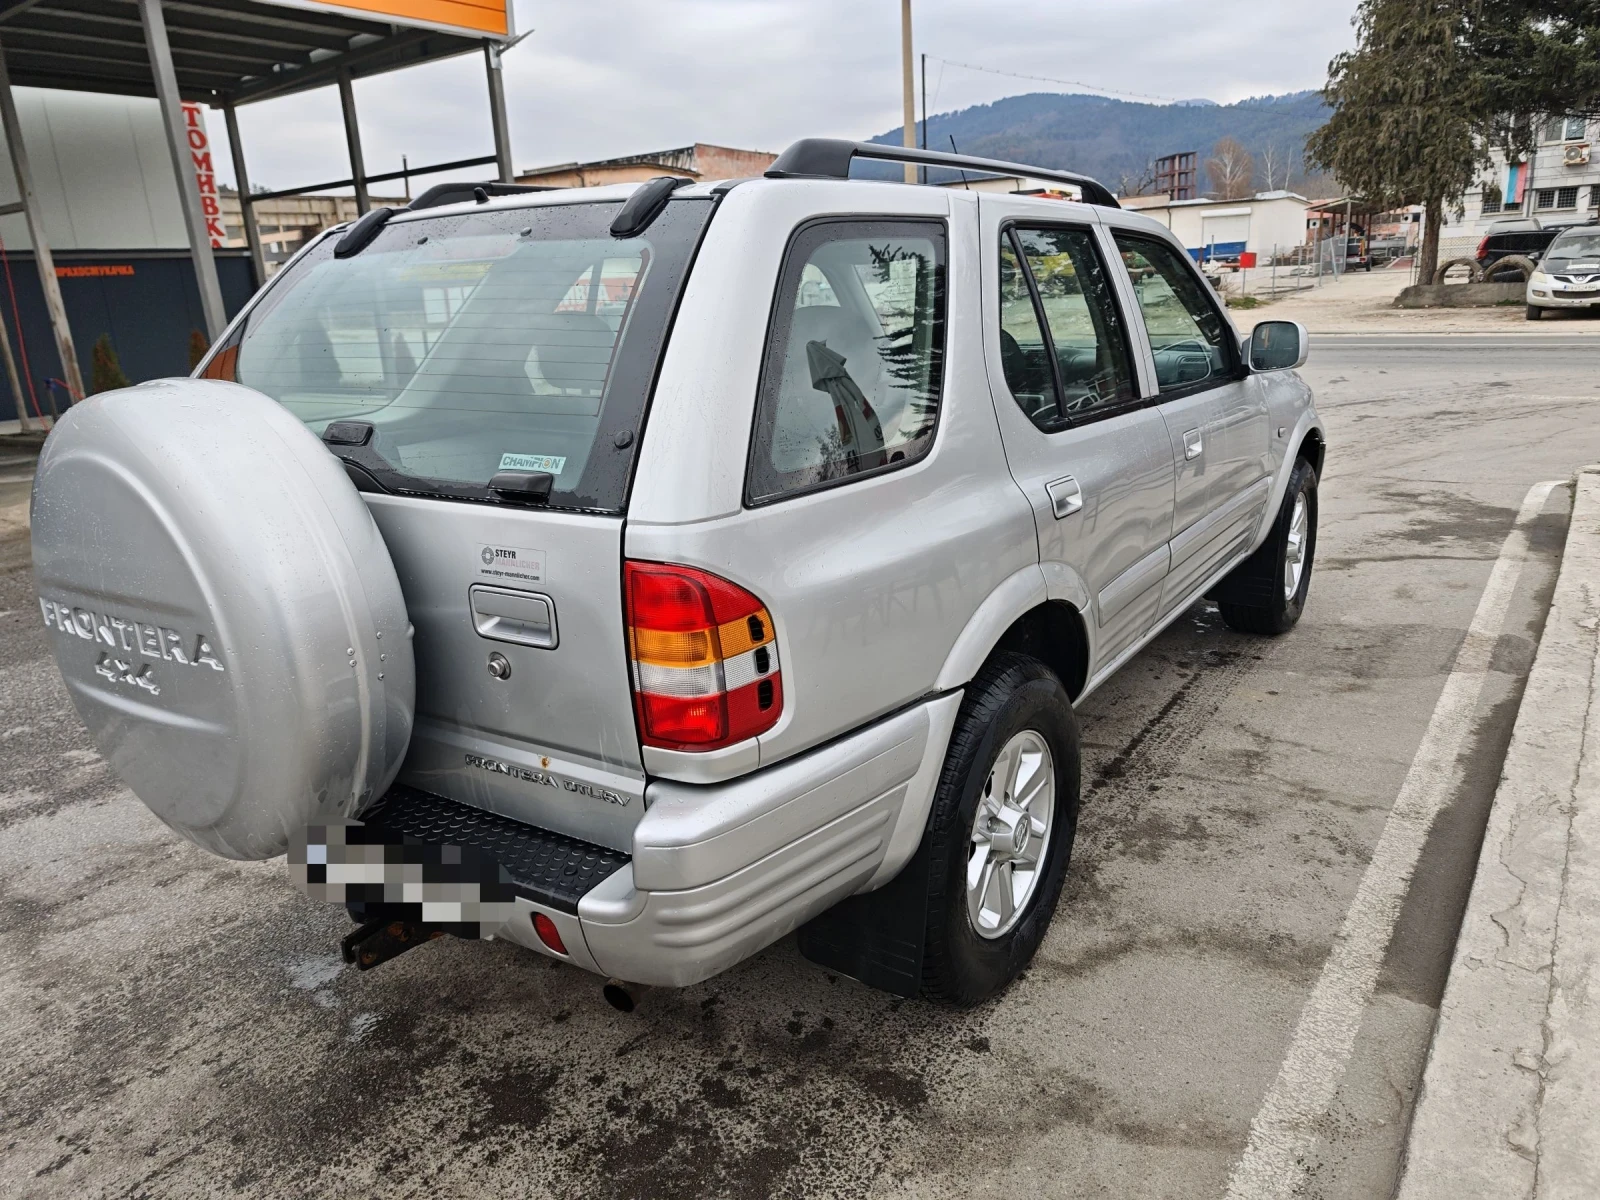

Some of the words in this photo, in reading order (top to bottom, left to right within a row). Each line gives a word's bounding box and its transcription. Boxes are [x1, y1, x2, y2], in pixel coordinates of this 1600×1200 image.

[502, 456, 561, 469] CHAMPION
[495, 549, 516, 559] STEYR
[39, 597, 224, 671] FRONTERA
[465, 754, 559, 789] FRONTERA
